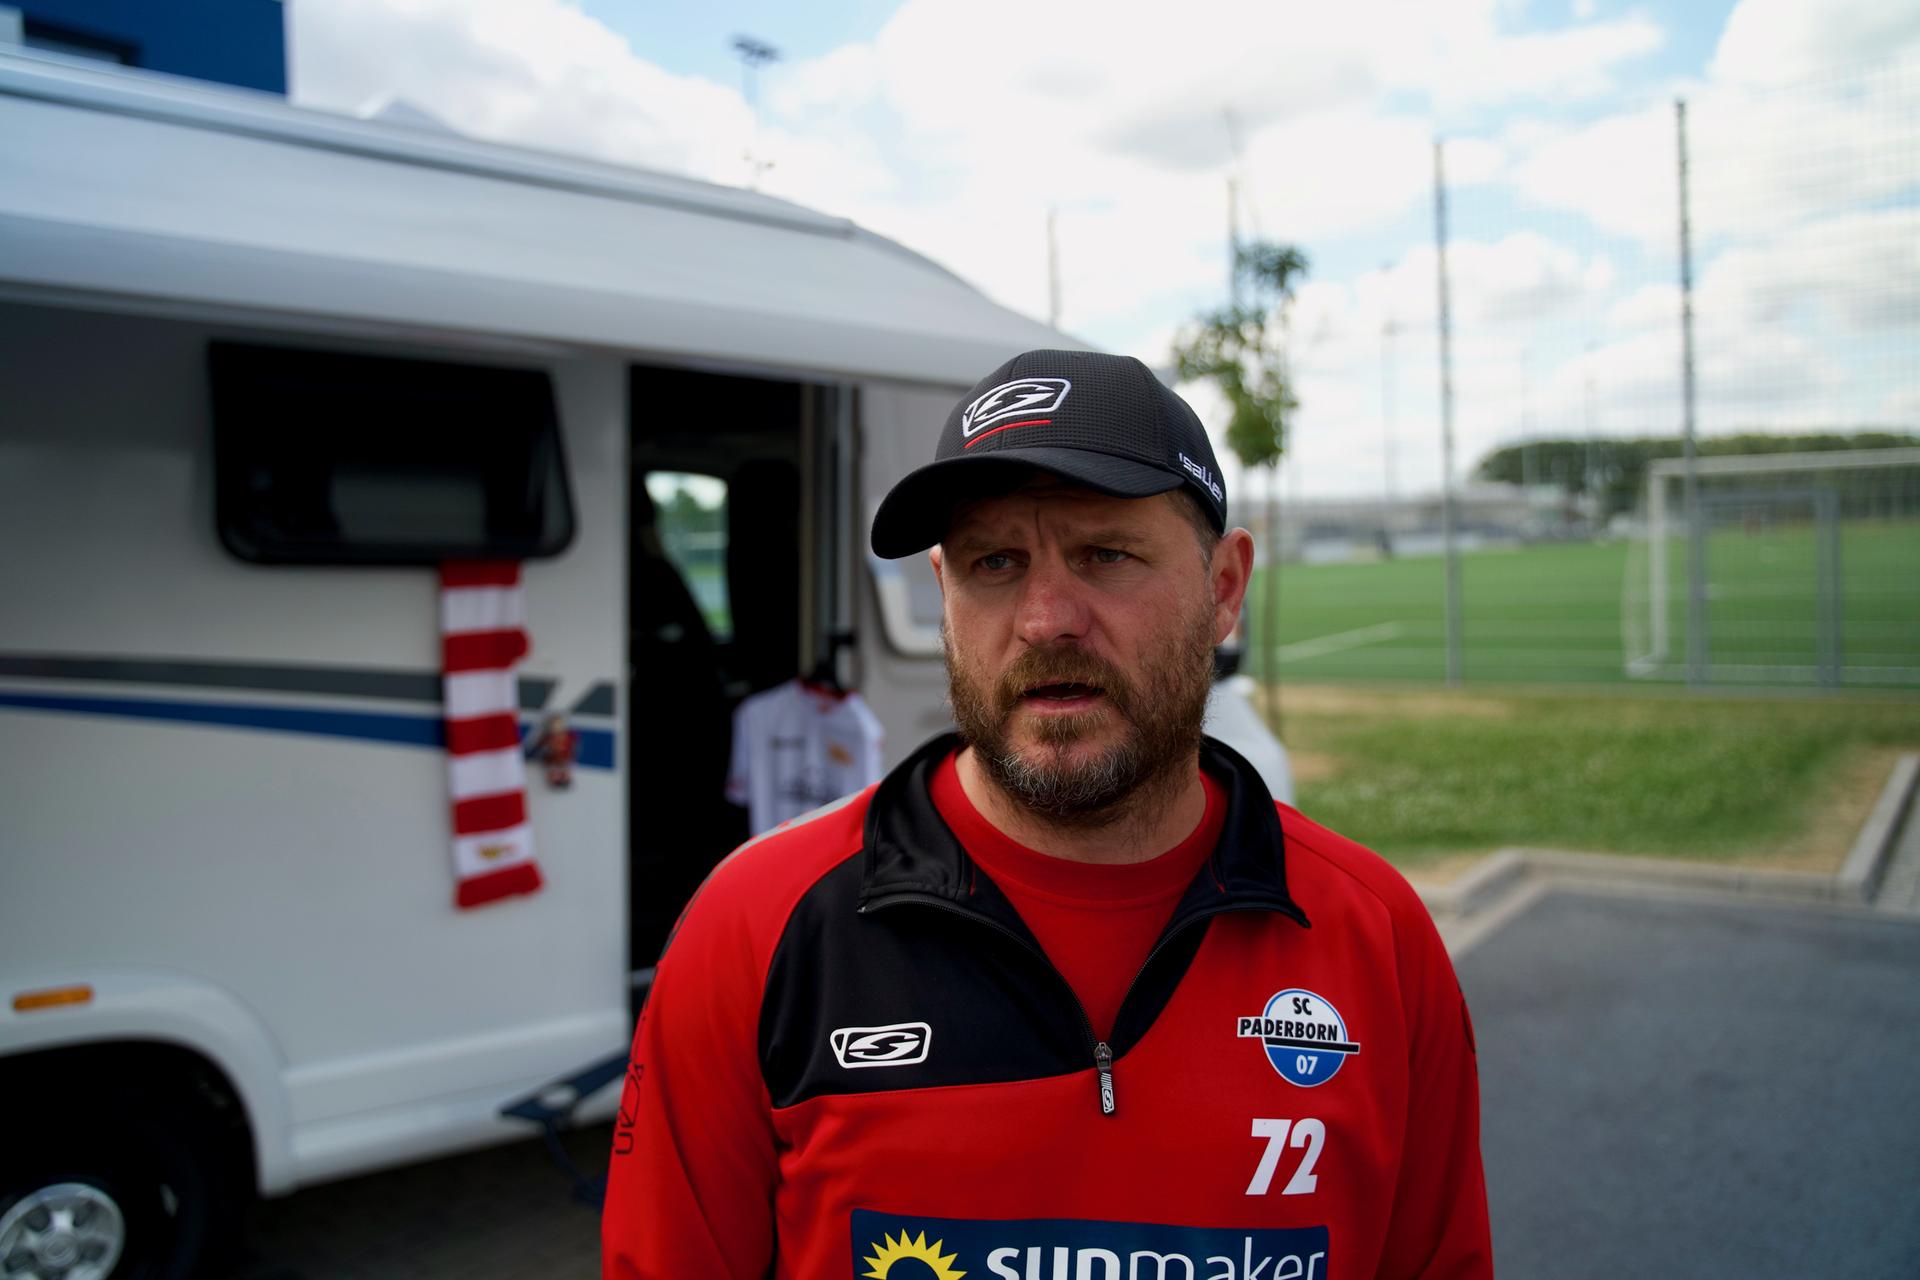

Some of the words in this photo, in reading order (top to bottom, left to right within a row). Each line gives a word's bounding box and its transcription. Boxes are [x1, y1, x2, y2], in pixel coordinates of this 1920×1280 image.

[1293, 997, 1312, 1016] SC
[1239, 1018, 1338, 1042] PADERBORN
[1296, 1054, 1318, 1075] 07
[1245, 1118, 1326, 1196] 72
